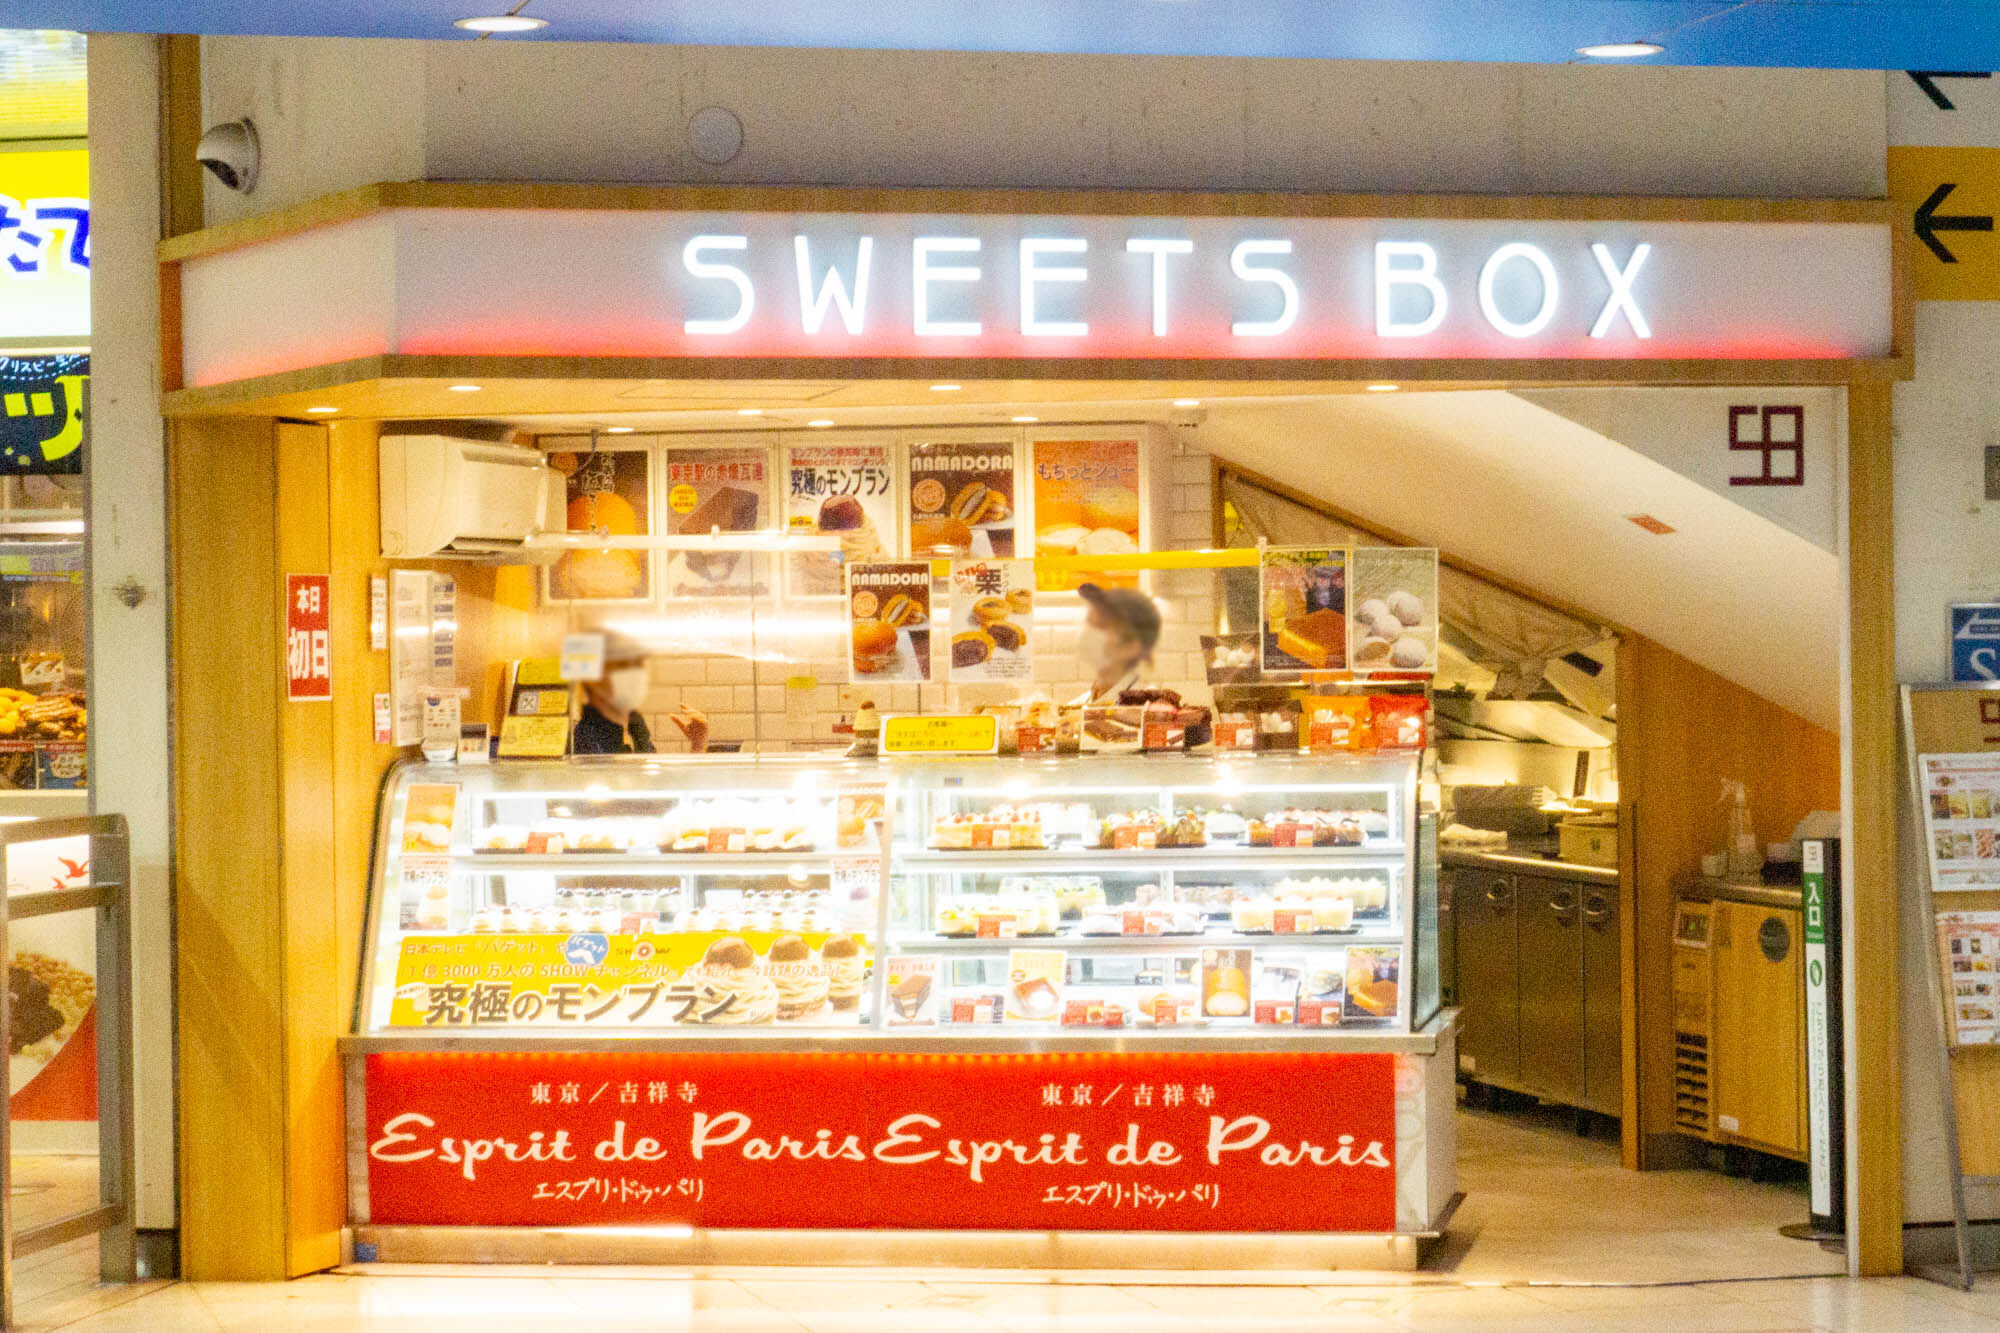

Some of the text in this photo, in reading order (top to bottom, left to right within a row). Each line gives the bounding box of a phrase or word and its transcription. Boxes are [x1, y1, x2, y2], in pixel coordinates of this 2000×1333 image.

[683, 234, 1652, 340] SWEETS BOX
[791, 465, 890, 496] 究極のモンブラン
[289, 627, 329, 679] 初日
[1808, 882, 1821, 927] 入口
[425, 979, 739, 1026] 究極のモンブラン
[370, 1111, 867, 1181] Esprit de Paris
[873, 1113, 1392, 1182] Esprit de Paris
[532, 1177, 704, 1203] エスプリ・ドゥ・パリ
[1041, 1181, 1220, 1209] エスプリ・ドゥ・パリ
